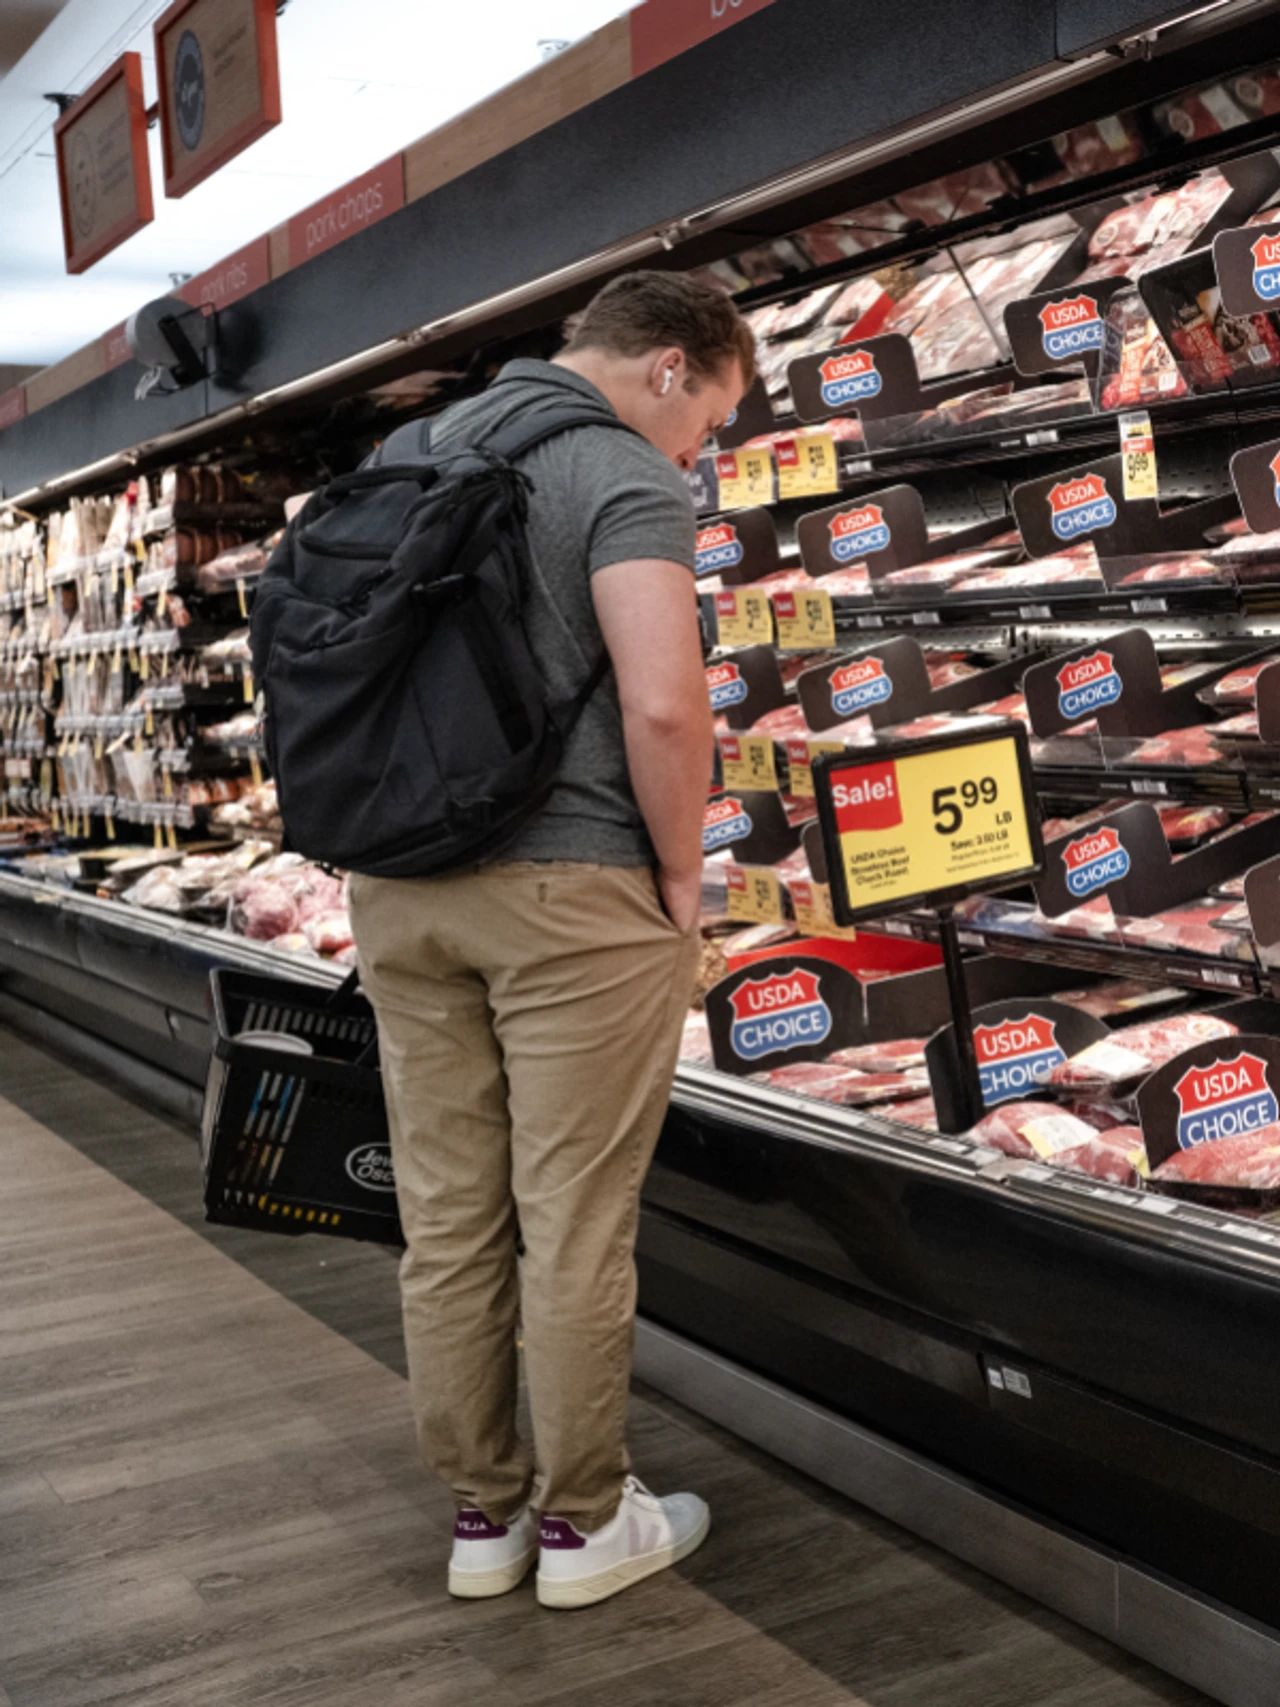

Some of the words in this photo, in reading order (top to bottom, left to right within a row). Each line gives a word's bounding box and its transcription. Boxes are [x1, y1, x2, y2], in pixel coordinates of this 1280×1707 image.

[305, 216, 339, 253] pork
[338, 182, 383, 231] chops
[1051, 304, 1090, 325] USDA
[1049, 325, 1103, 350] CHOICE
[830, 361, 866, 377] USDA
[827, 376, 878, 398] CHOICE
[1059, 484, 1097, 507] USDA
[839, 514, 875, 532] USDA
[1058, 505, 1112, 533] CHOICE
[835, 530, 886, 555] CHOICE
[706, 668, 731, 686] SDA
[839, 665, 875, 686] USDA
[1067, 660, 1105, 685] USDA
[711, 687, 743, 706] OICE
[836, 681, 887, 708] CHOICE
[1064, 681, 1118, 712] CHOICE
[832, 774, 894, 808] Sale!
[995, 811, 1012, 825] LB
[1073, 837, 1110, 861] USDA
[1072, 857, 1126, 888] CHOICE
[748, 982, 805, 1011] USDA
[740, 1011, 824, 1048] CHOICE
[981, 1026, 1040, 1056] USDA
[1194, 1067, 1252, 1102] USDA
[1187, 1101, 1270, 1147] CHOICE
[457, 1521, 488, 1531] VEJA
